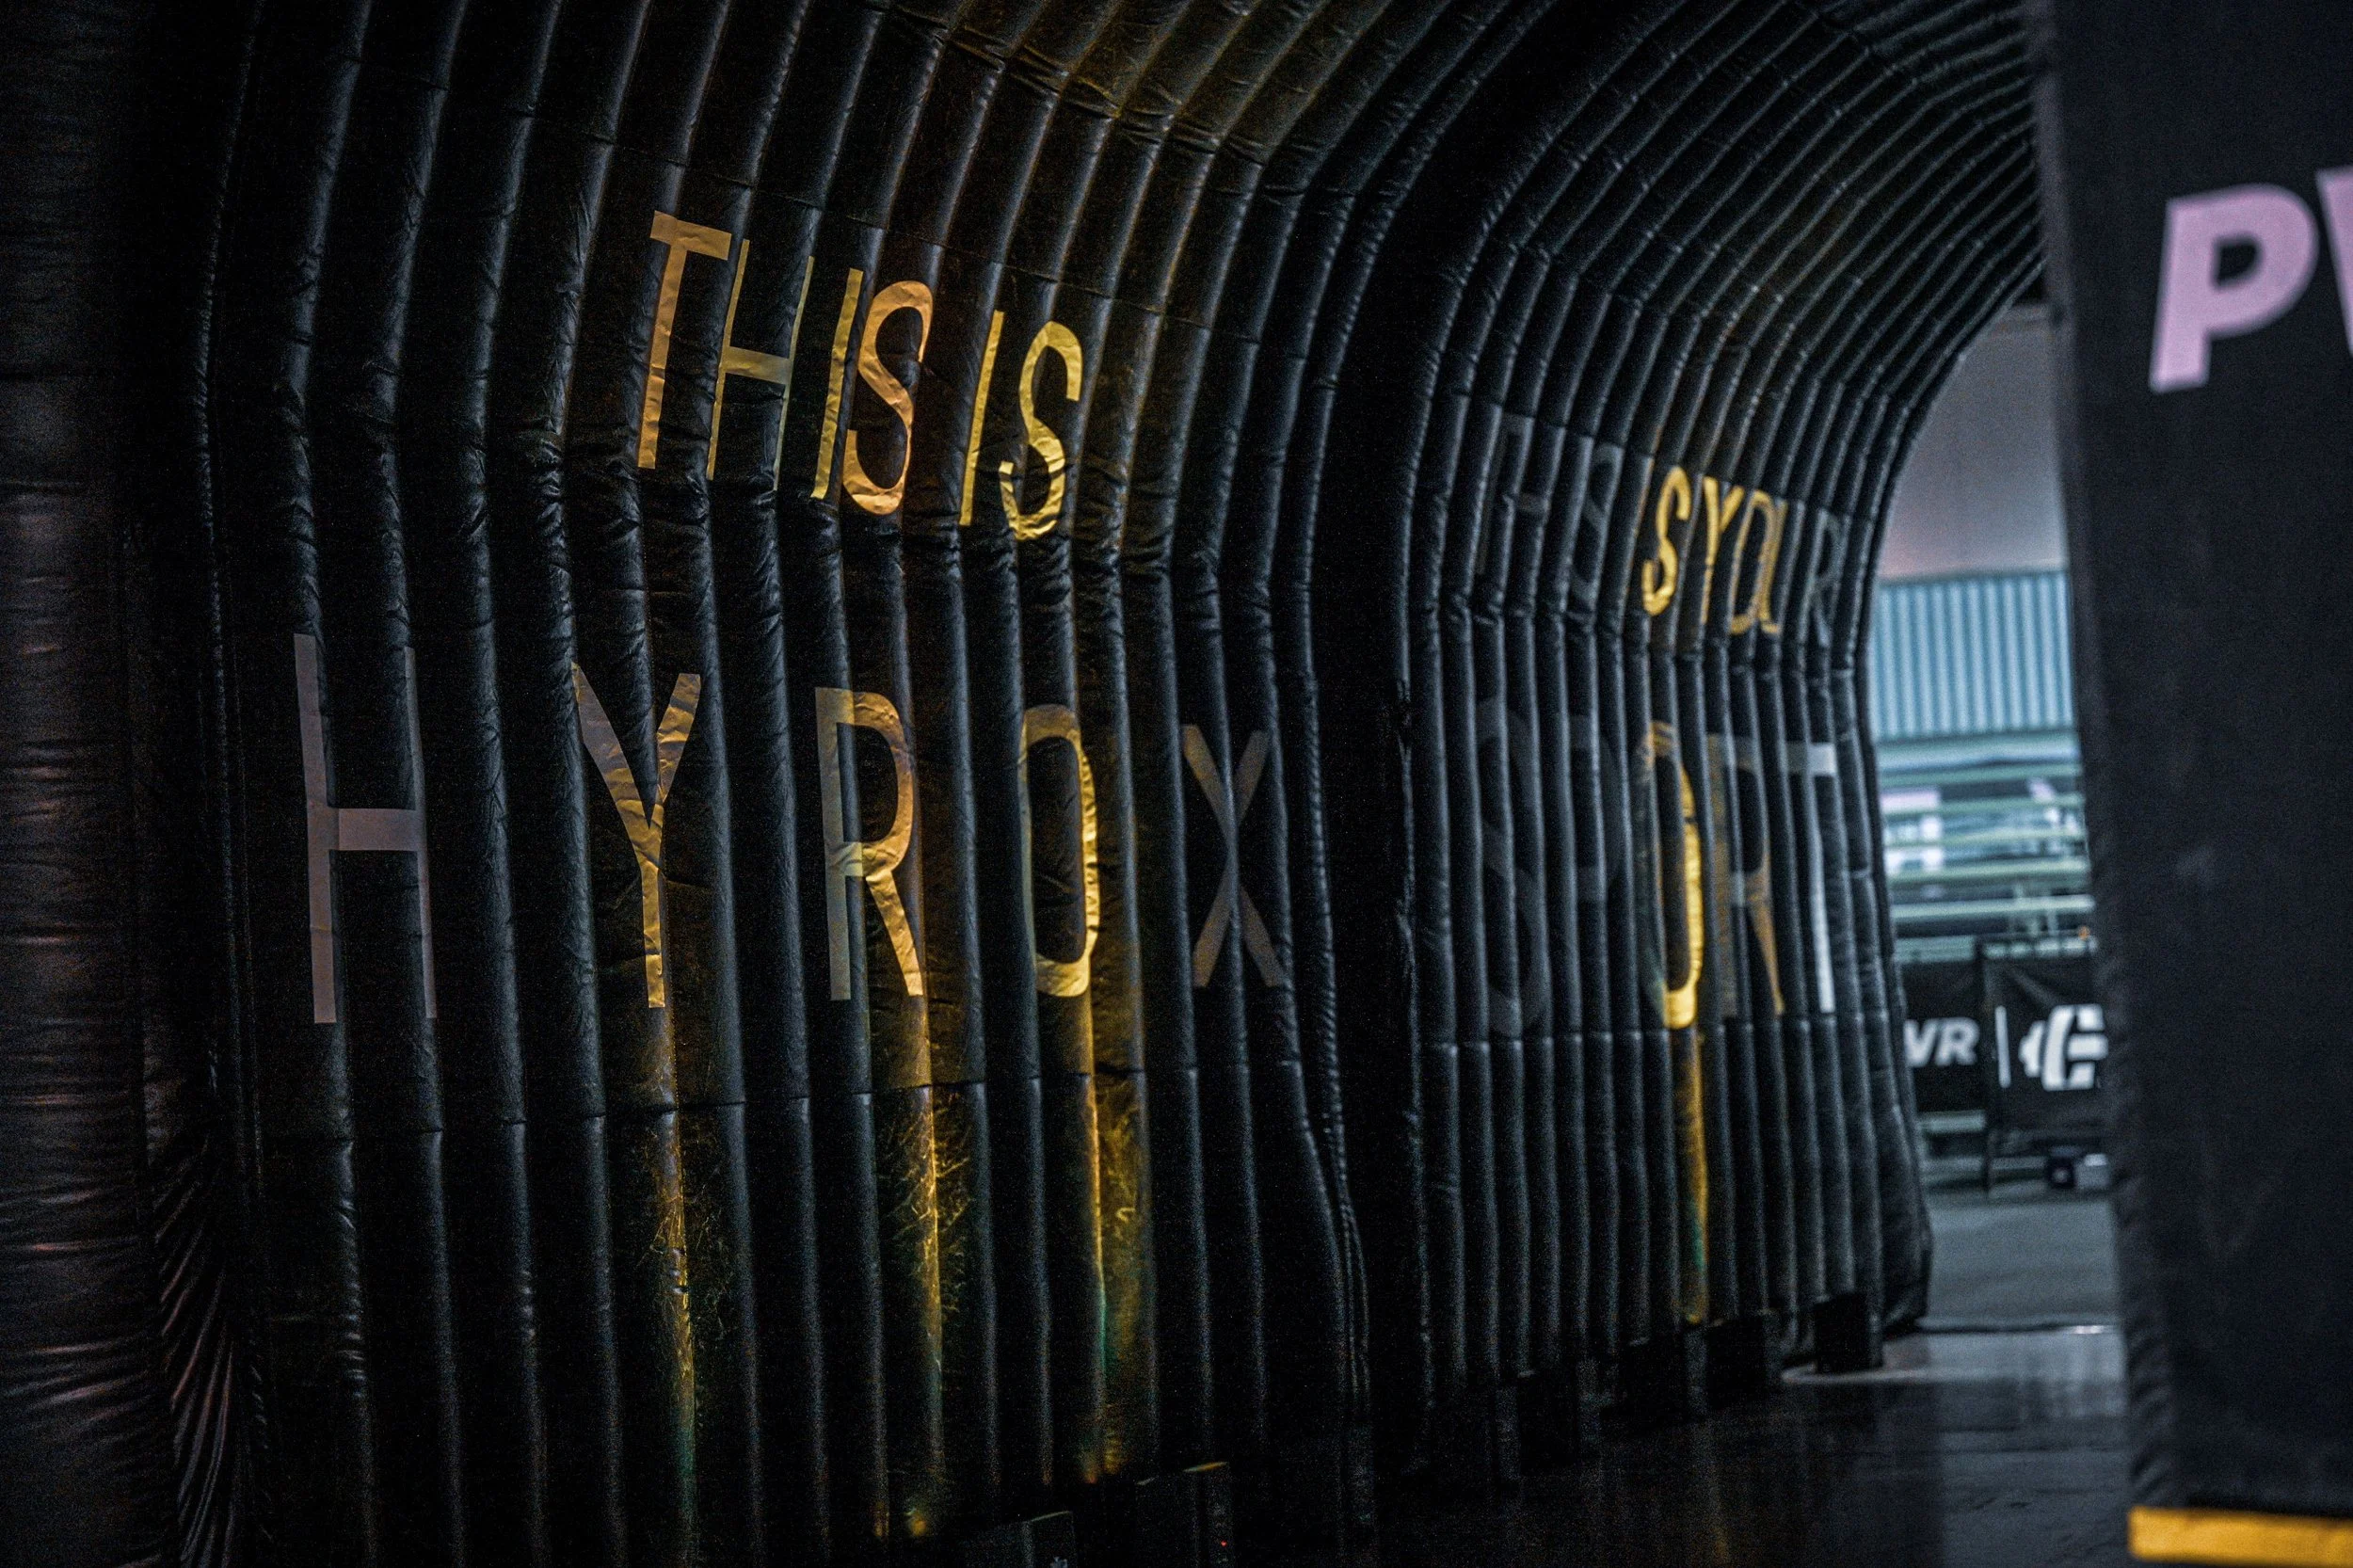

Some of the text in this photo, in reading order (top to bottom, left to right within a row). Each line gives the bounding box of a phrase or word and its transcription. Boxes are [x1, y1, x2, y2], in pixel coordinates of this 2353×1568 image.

[637, 210, 1084, 541] THIS IS
[1474, 410, 1625, 610] THS
[294, 632, 1289, 1025] HYROX
[1475, 695, 1840, 1032] SPORT
